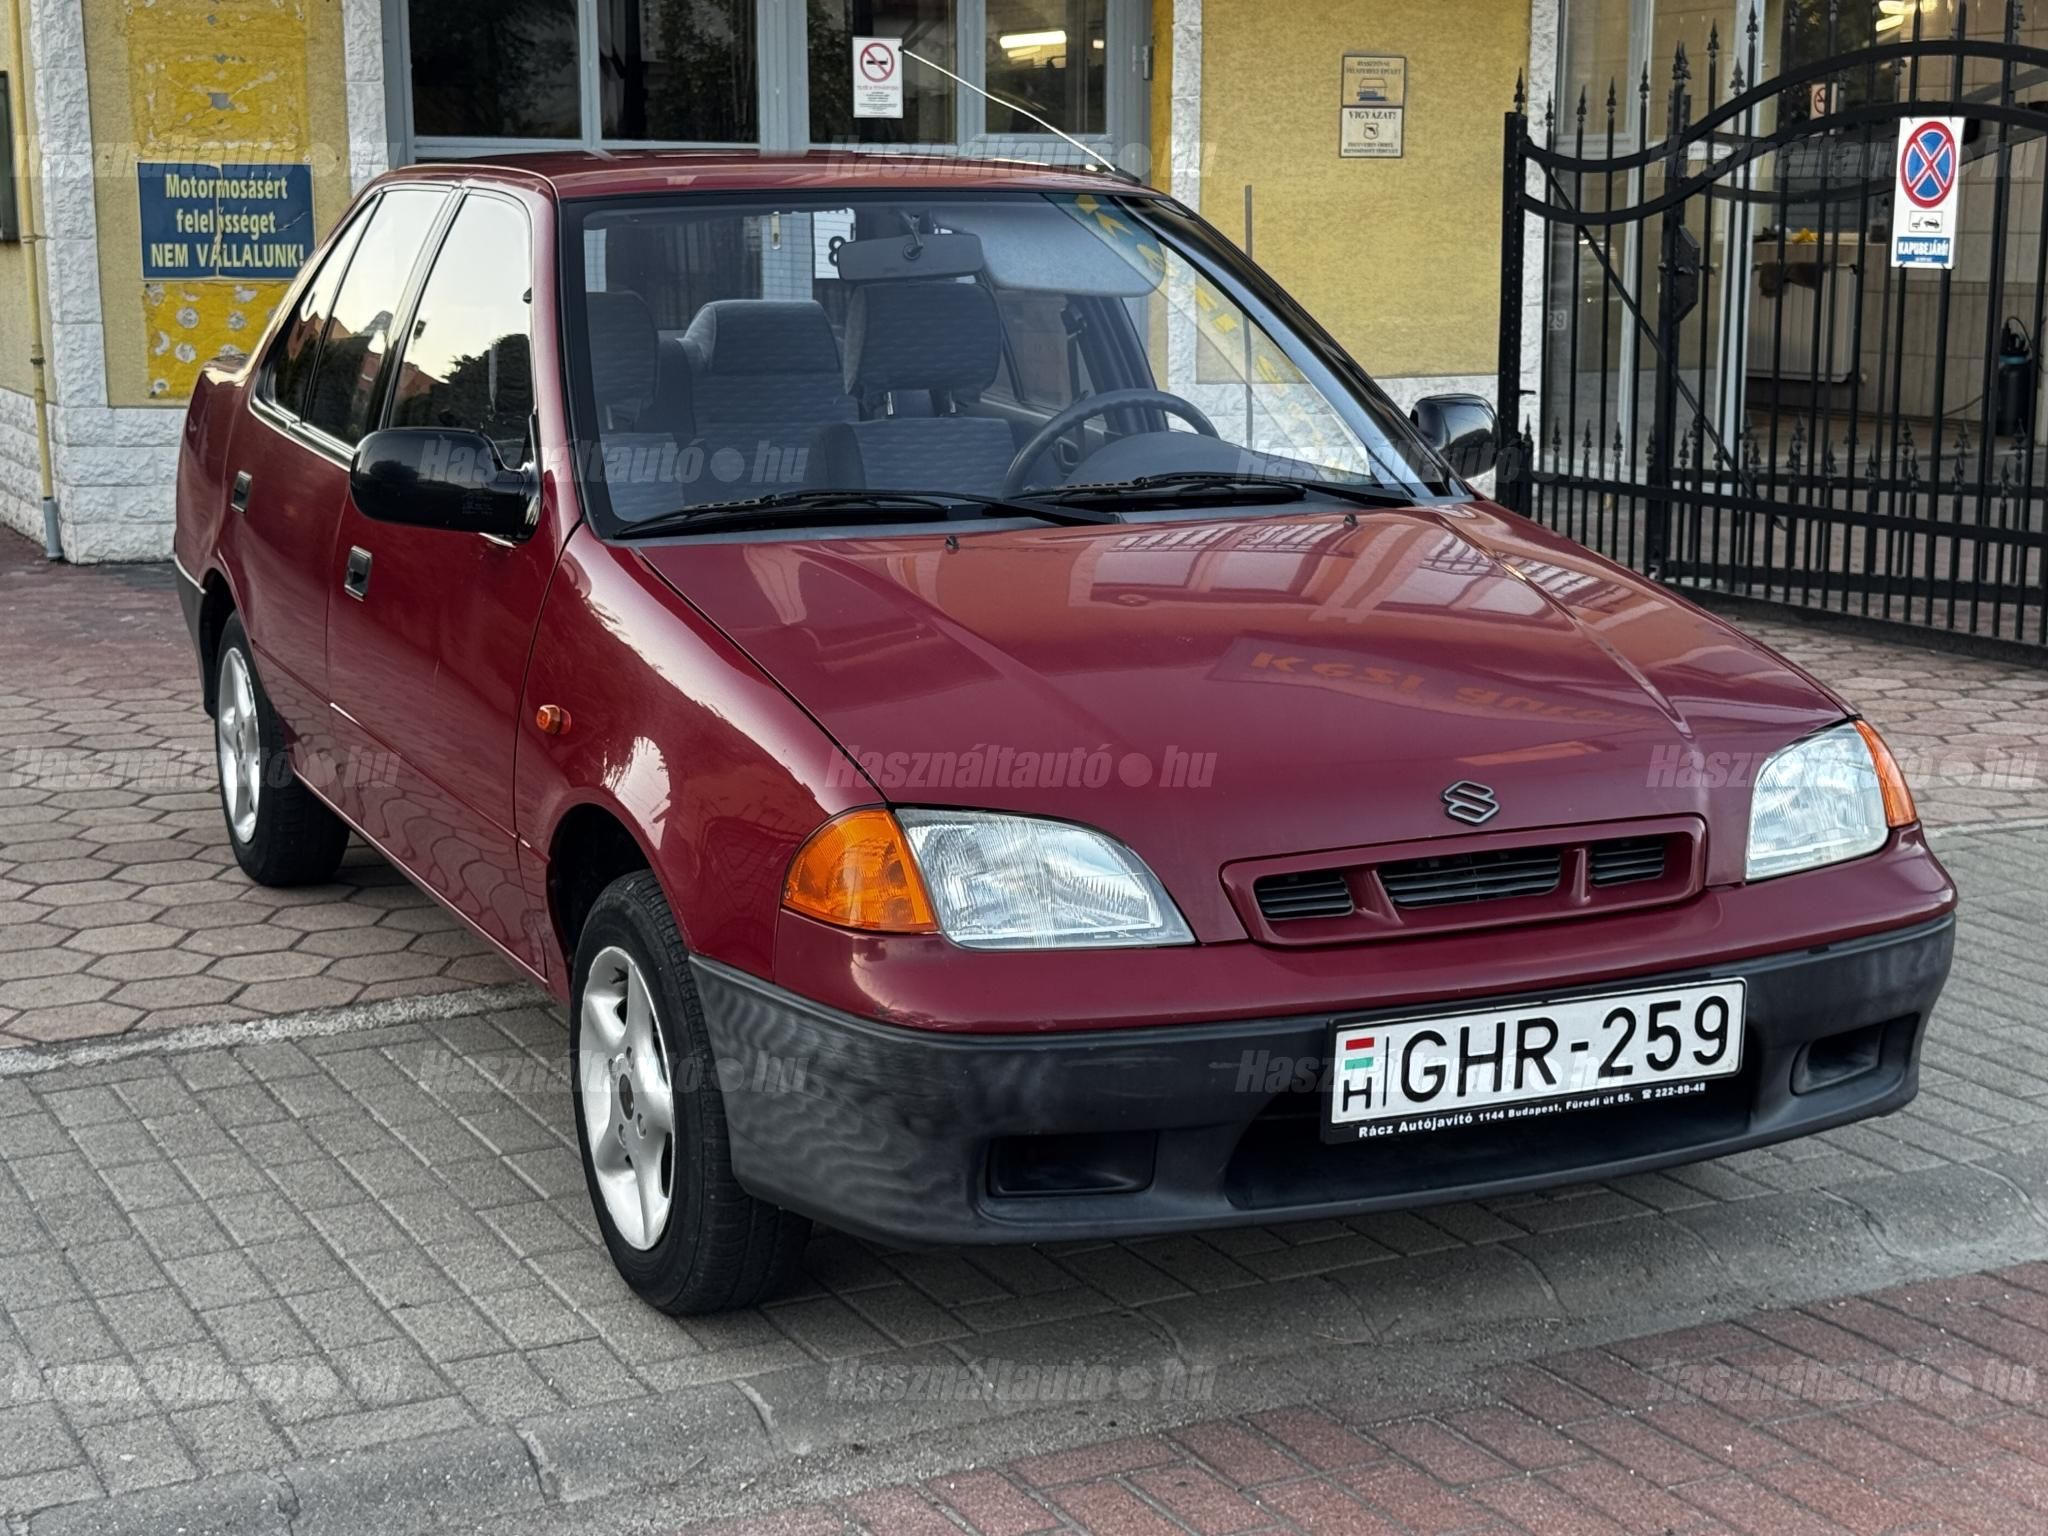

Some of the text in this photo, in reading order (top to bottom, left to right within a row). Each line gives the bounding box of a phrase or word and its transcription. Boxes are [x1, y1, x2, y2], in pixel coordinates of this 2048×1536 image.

[165, 171, 288, 200] Motormosásért
[151, 243, 188, 267] NEM
[1400, 995, 1730, 1103] GHR-259
[1358, 1124, 1394, 1139] Rácz
[1398, 1114, 1473, 1133] Autójavító
[1478, 1110, 1505, 1122] 1144
[1508, 1103, 1562, 1118] Budapest,
[1565, 1097, 1600, 1111] Füredi
